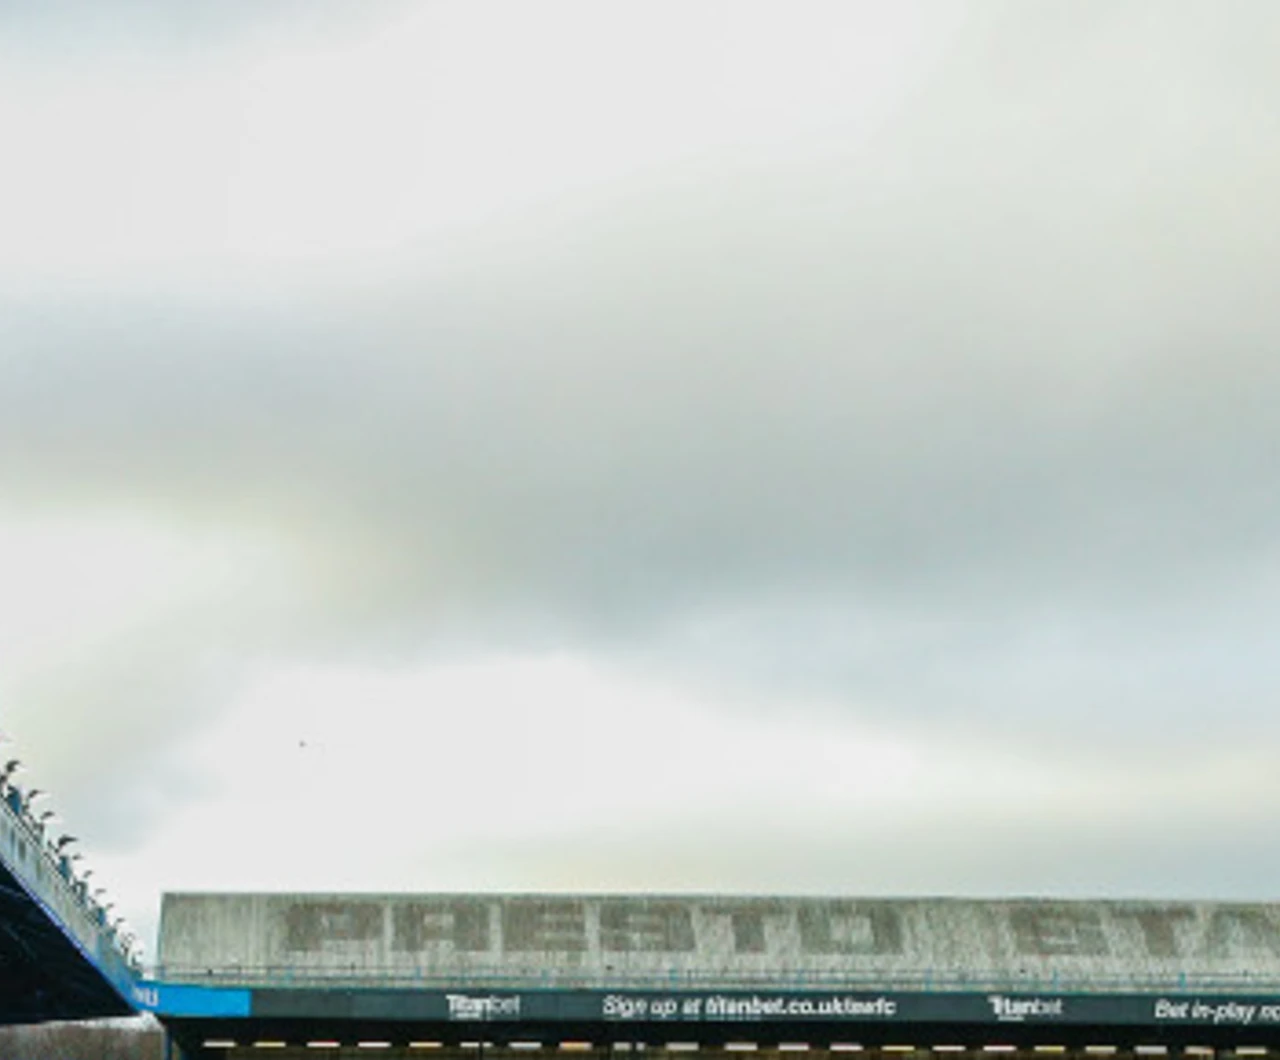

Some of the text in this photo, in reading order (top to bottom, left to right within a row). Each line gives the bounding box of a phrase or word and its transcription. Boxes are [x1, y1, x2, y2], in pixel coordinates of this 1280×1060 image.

[602, 995, 647, 1018] Sign
[650, 999, 677, 1017] up
[1154, 999, 1187, 1018] Bet
[1191, 1000, 1254, 1023] in-play
